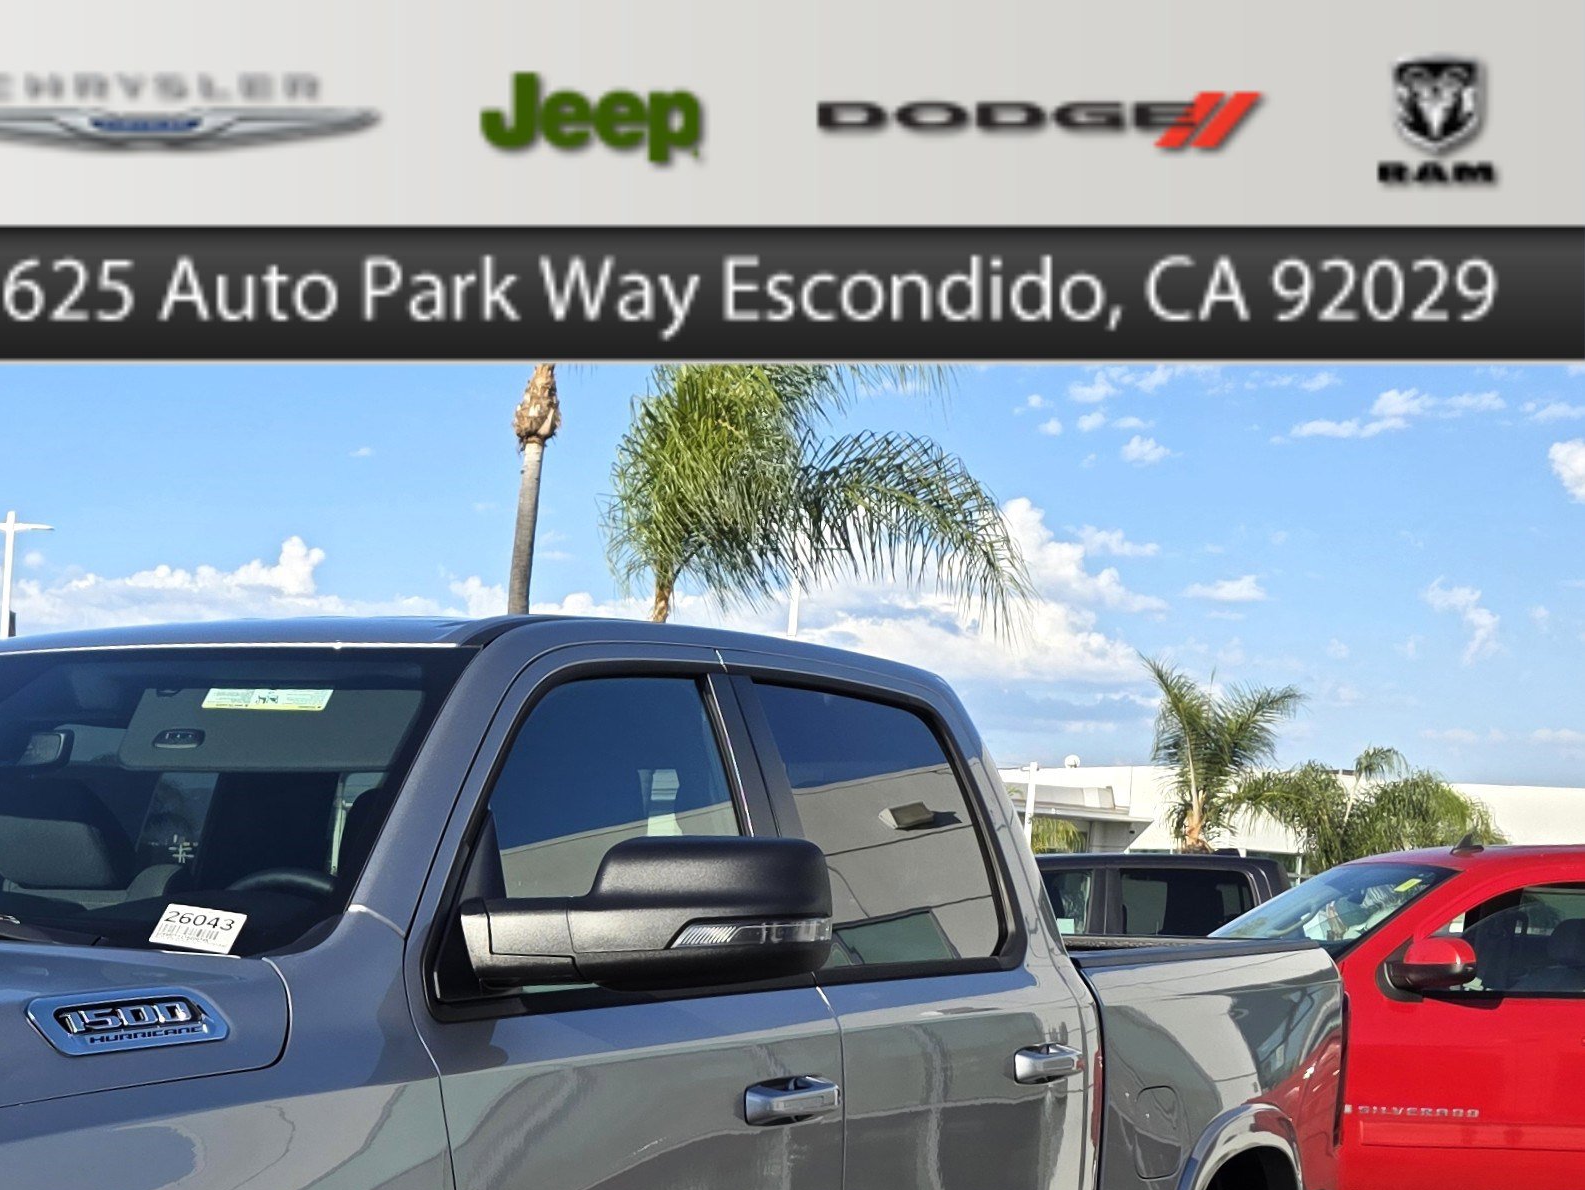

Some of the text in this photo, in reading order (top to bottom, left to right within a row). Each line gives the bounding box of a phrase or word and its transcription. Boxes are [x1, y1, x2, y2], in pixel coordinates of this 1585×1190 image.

[164, 910, 235, 931] 26043
[58, 1002, 193, 1034] 1500
[89, 1025, 204, 1044] HURRICANE
[1358, 1105, 1480, 1118] SILVERADO
